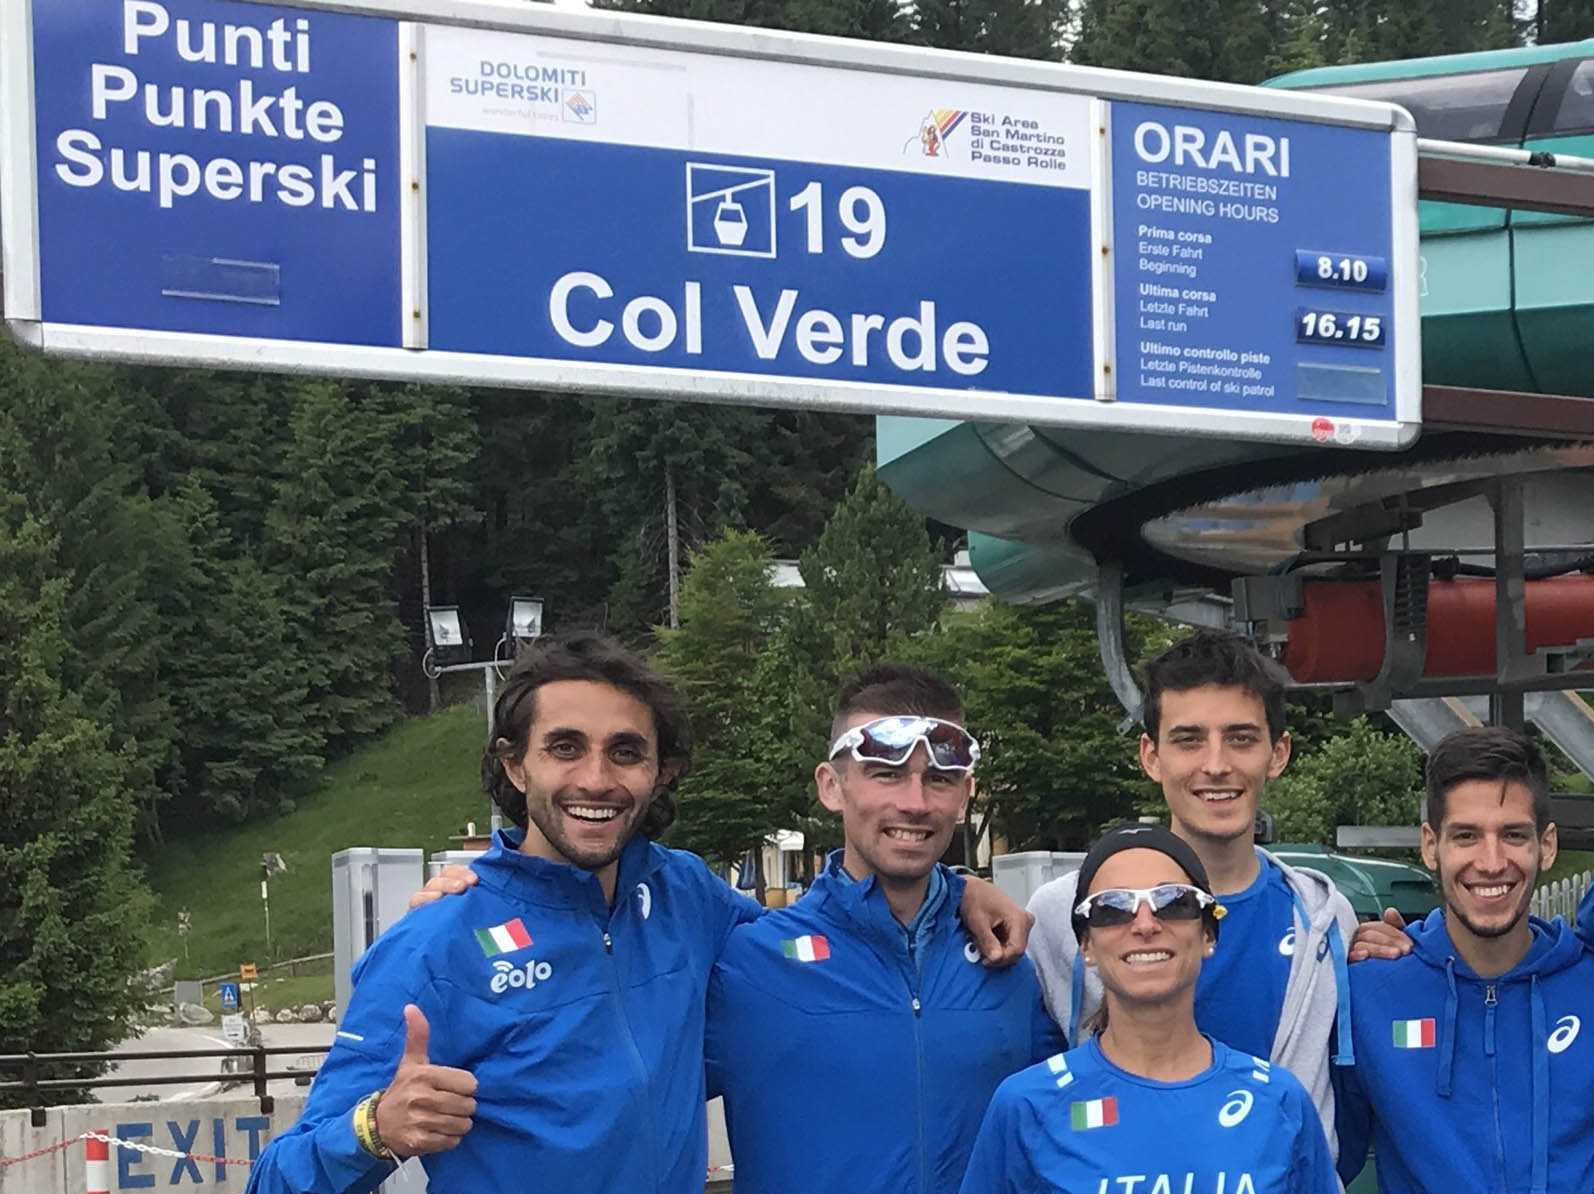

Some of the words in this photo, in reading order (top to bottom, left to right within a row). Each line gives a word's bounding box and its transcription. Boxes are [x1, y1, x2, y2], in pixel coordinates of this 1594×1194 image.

[124, 0, 310, 72] Punti
[480, 60, 586, 86] DOLOMITI
[91, 63, 344, 142] Punkte
[450, 77, 559, 103] SUPERSKI
[970, 112, 995, 125] Ski
[1001, 115, 1039, 130] Area
[970, 125, 1000, 138] San
[1005, 129, 1065, 145] Martino
[970, 138, 984, 150] di
[990, 140, 1066, 158] Castrozza
[971, 151, 1021, 166] Passo
[1027, 156, 1066, 171] Rolle
[1134, 122, 1290, 178] ORARI
[55, 129, 376, 213] Superski
[1136, 171, 1278, 201] BETRIEBSZEITEN
[789, 181, 887, 259] 19
[1136, 194, 1216, 217] OPENING
[1220, 202, 1279, 223] HOURS
[1138, 225, 1175, 240] Prima
[1178, 231, 1212, 244] corsa
[1139, 241, 1170, 256] Erste
[1172, 245, 1204, 260] Fahrt
[1140, 258, 1197, 278] Beginning
[1317, 256, 1368, 283] 8.10
[1140, 283, 1180, 298] Ultima
[1182, 289, 1217, 302] corsa
[1140, 300, 1176, 314] Letzte
[1178, 304, 1209, 318] Fahrt
[549, 271, 704, 354] Col
[733, 285, 990, 375] Verde
[1140, 316, 1166, 330] Last
[1168, 322, 1188, 333] run
[1302, 312, 1382, 341] 16.15
[1140, 341, 1181, 357] Ultimo
[1184, 346, 1238, 362] controllo
[1240, 350, 1271, 365] piste
[1140, 358, 1176, 373] Letzte
[1178, 362, 1263, 380] Pistenkontrolle
[1140, 374, 1166, 390] Last
[1168, 377, 1208, 392] control
[1210, 380, 1222, 392] of
[1224, 381, 1240, 394] ski
[1242, 384, 1275, 398] patrol
[490, 958, 553, 994] eolo
[116, 1116, 270, 1189] EXIT
